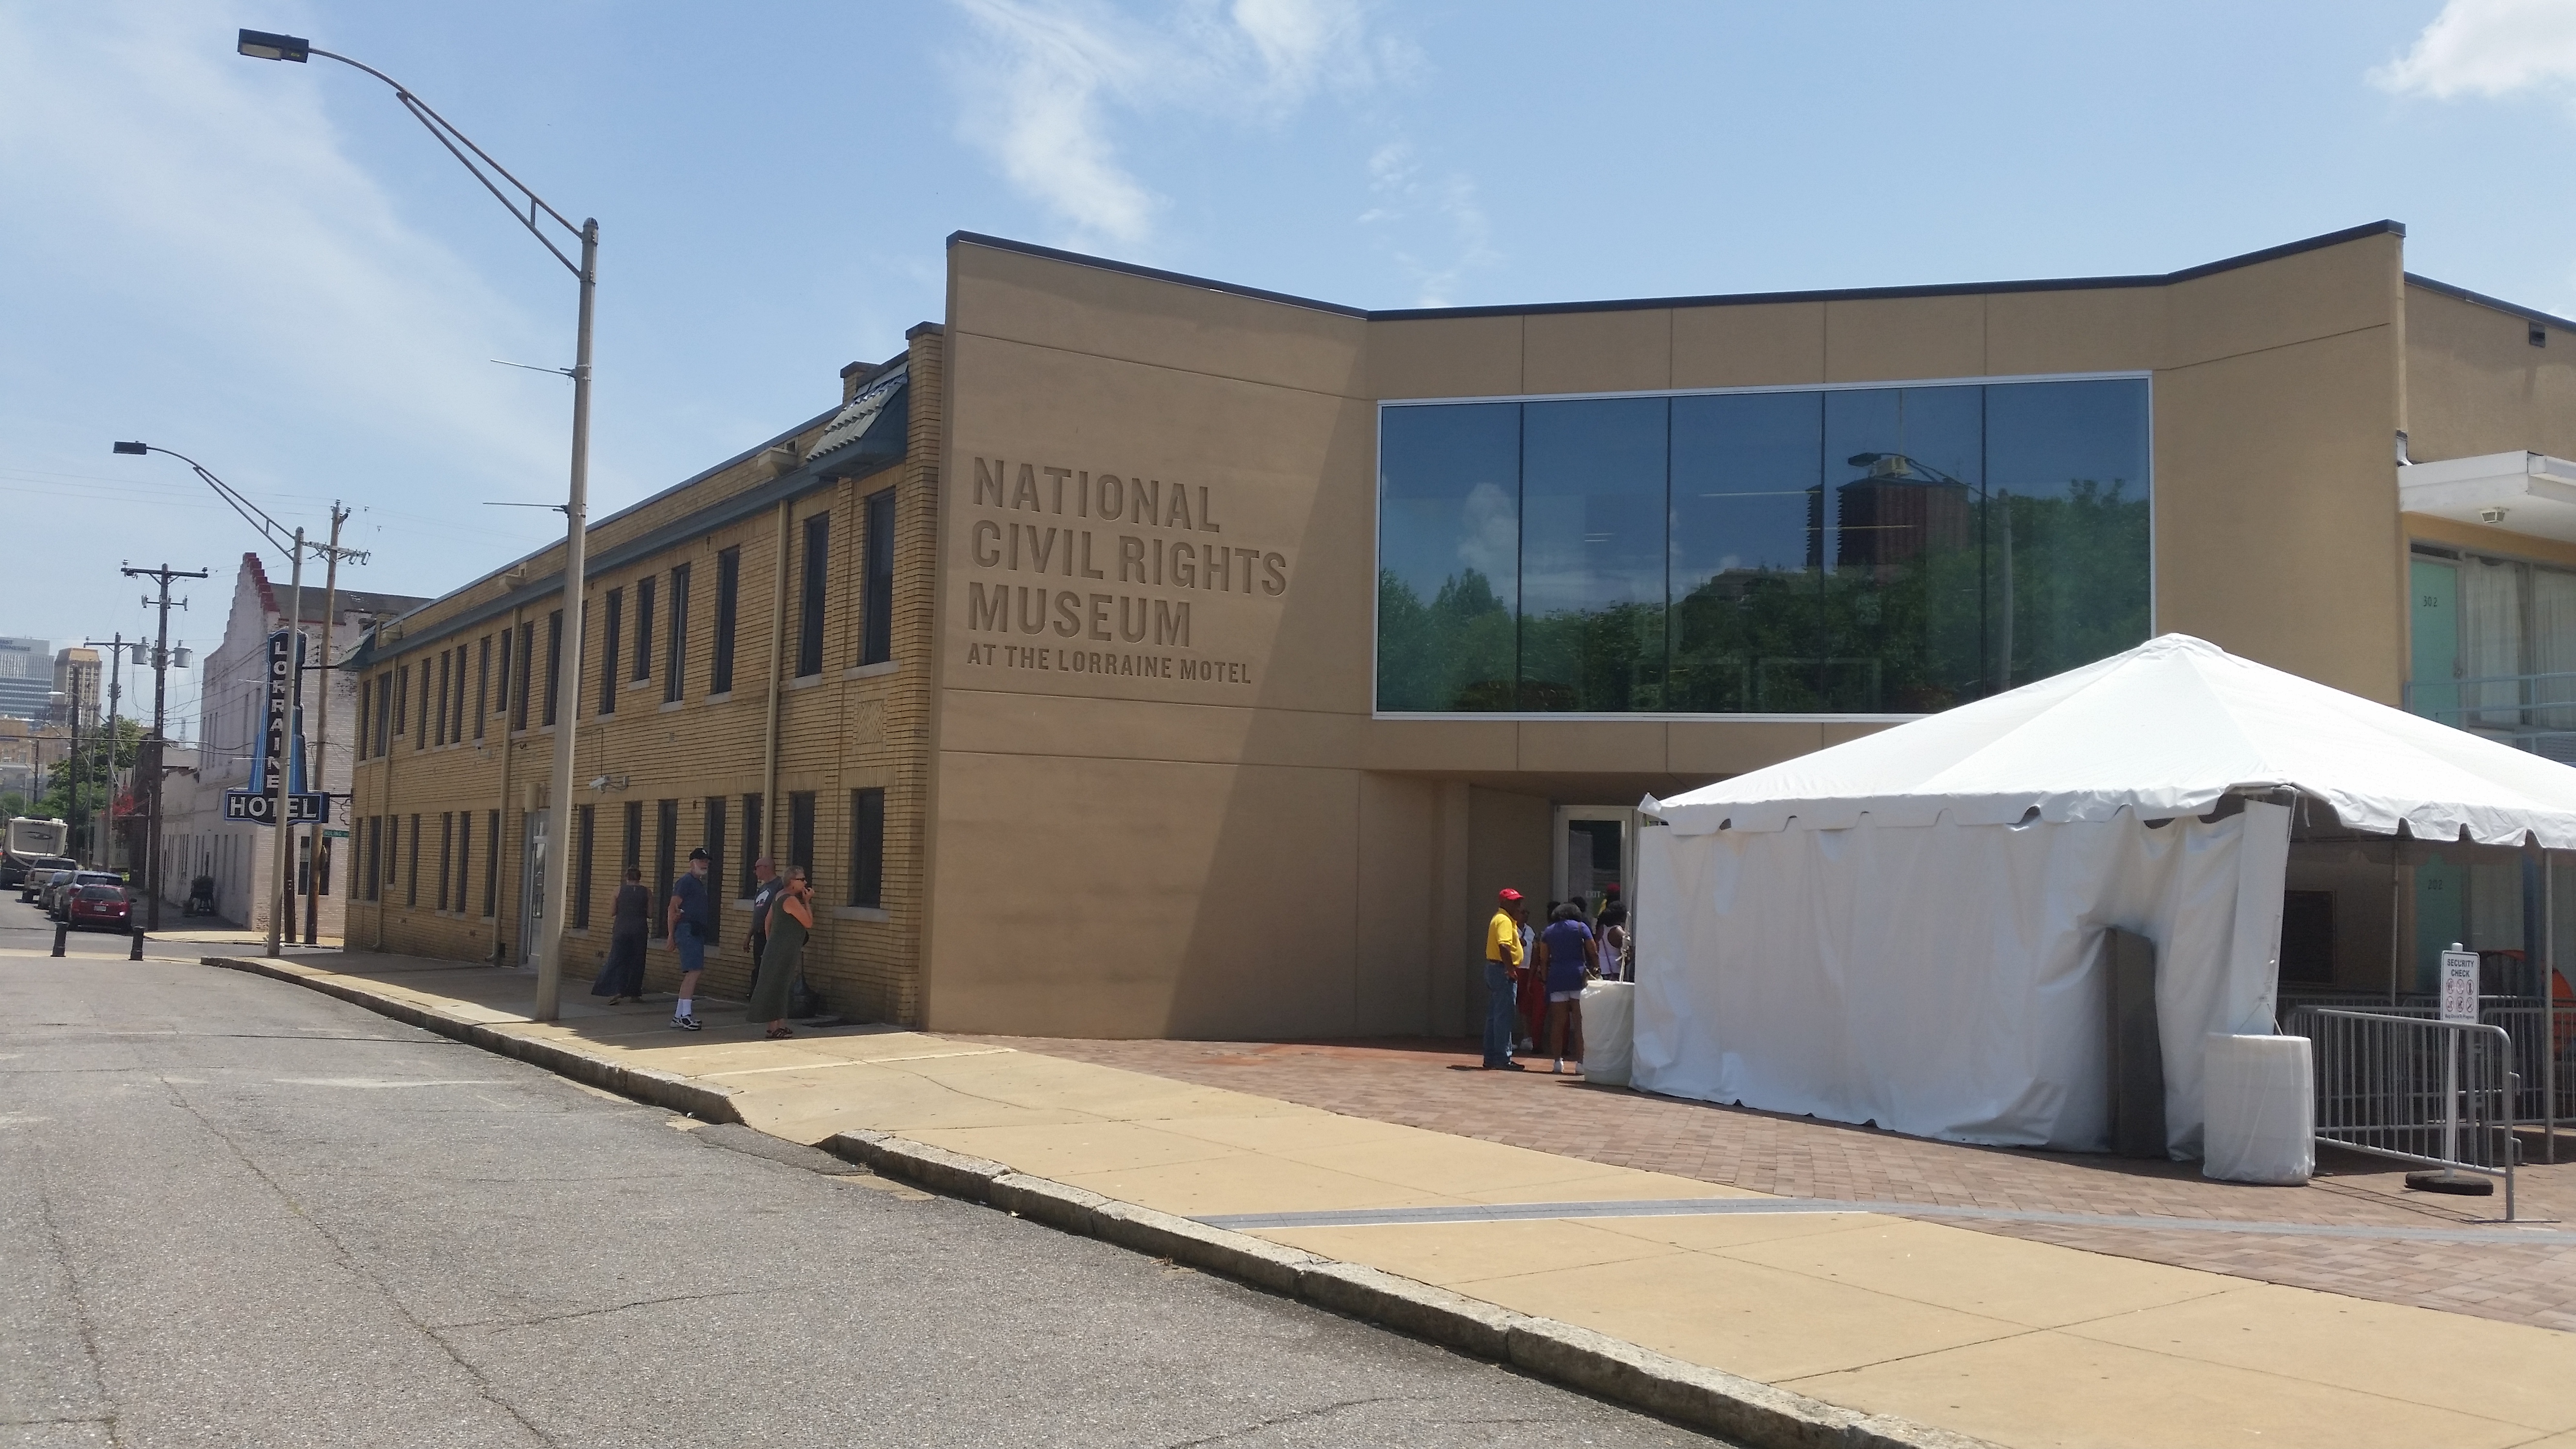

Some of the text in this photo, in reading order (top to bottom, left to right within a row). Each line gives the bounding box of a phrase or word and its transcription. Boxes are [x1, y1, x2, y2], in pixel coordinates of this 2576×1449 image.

[973, 457, 1220, 533] NATIONAL
[972, 520, 1286, 596] CIVIL RIGHTS
[968, 582, 1190, 648] MUSEUM
[2423, 596, 2437, 607] 302
[967, 643, 1251, 684] AT THE LORRAINE MOTEL
[230, 796, 317, 818] HOTEL
[2447, 959, 2474, 967] SECURITY
[2451, 969, 2470, 978] CHECK
